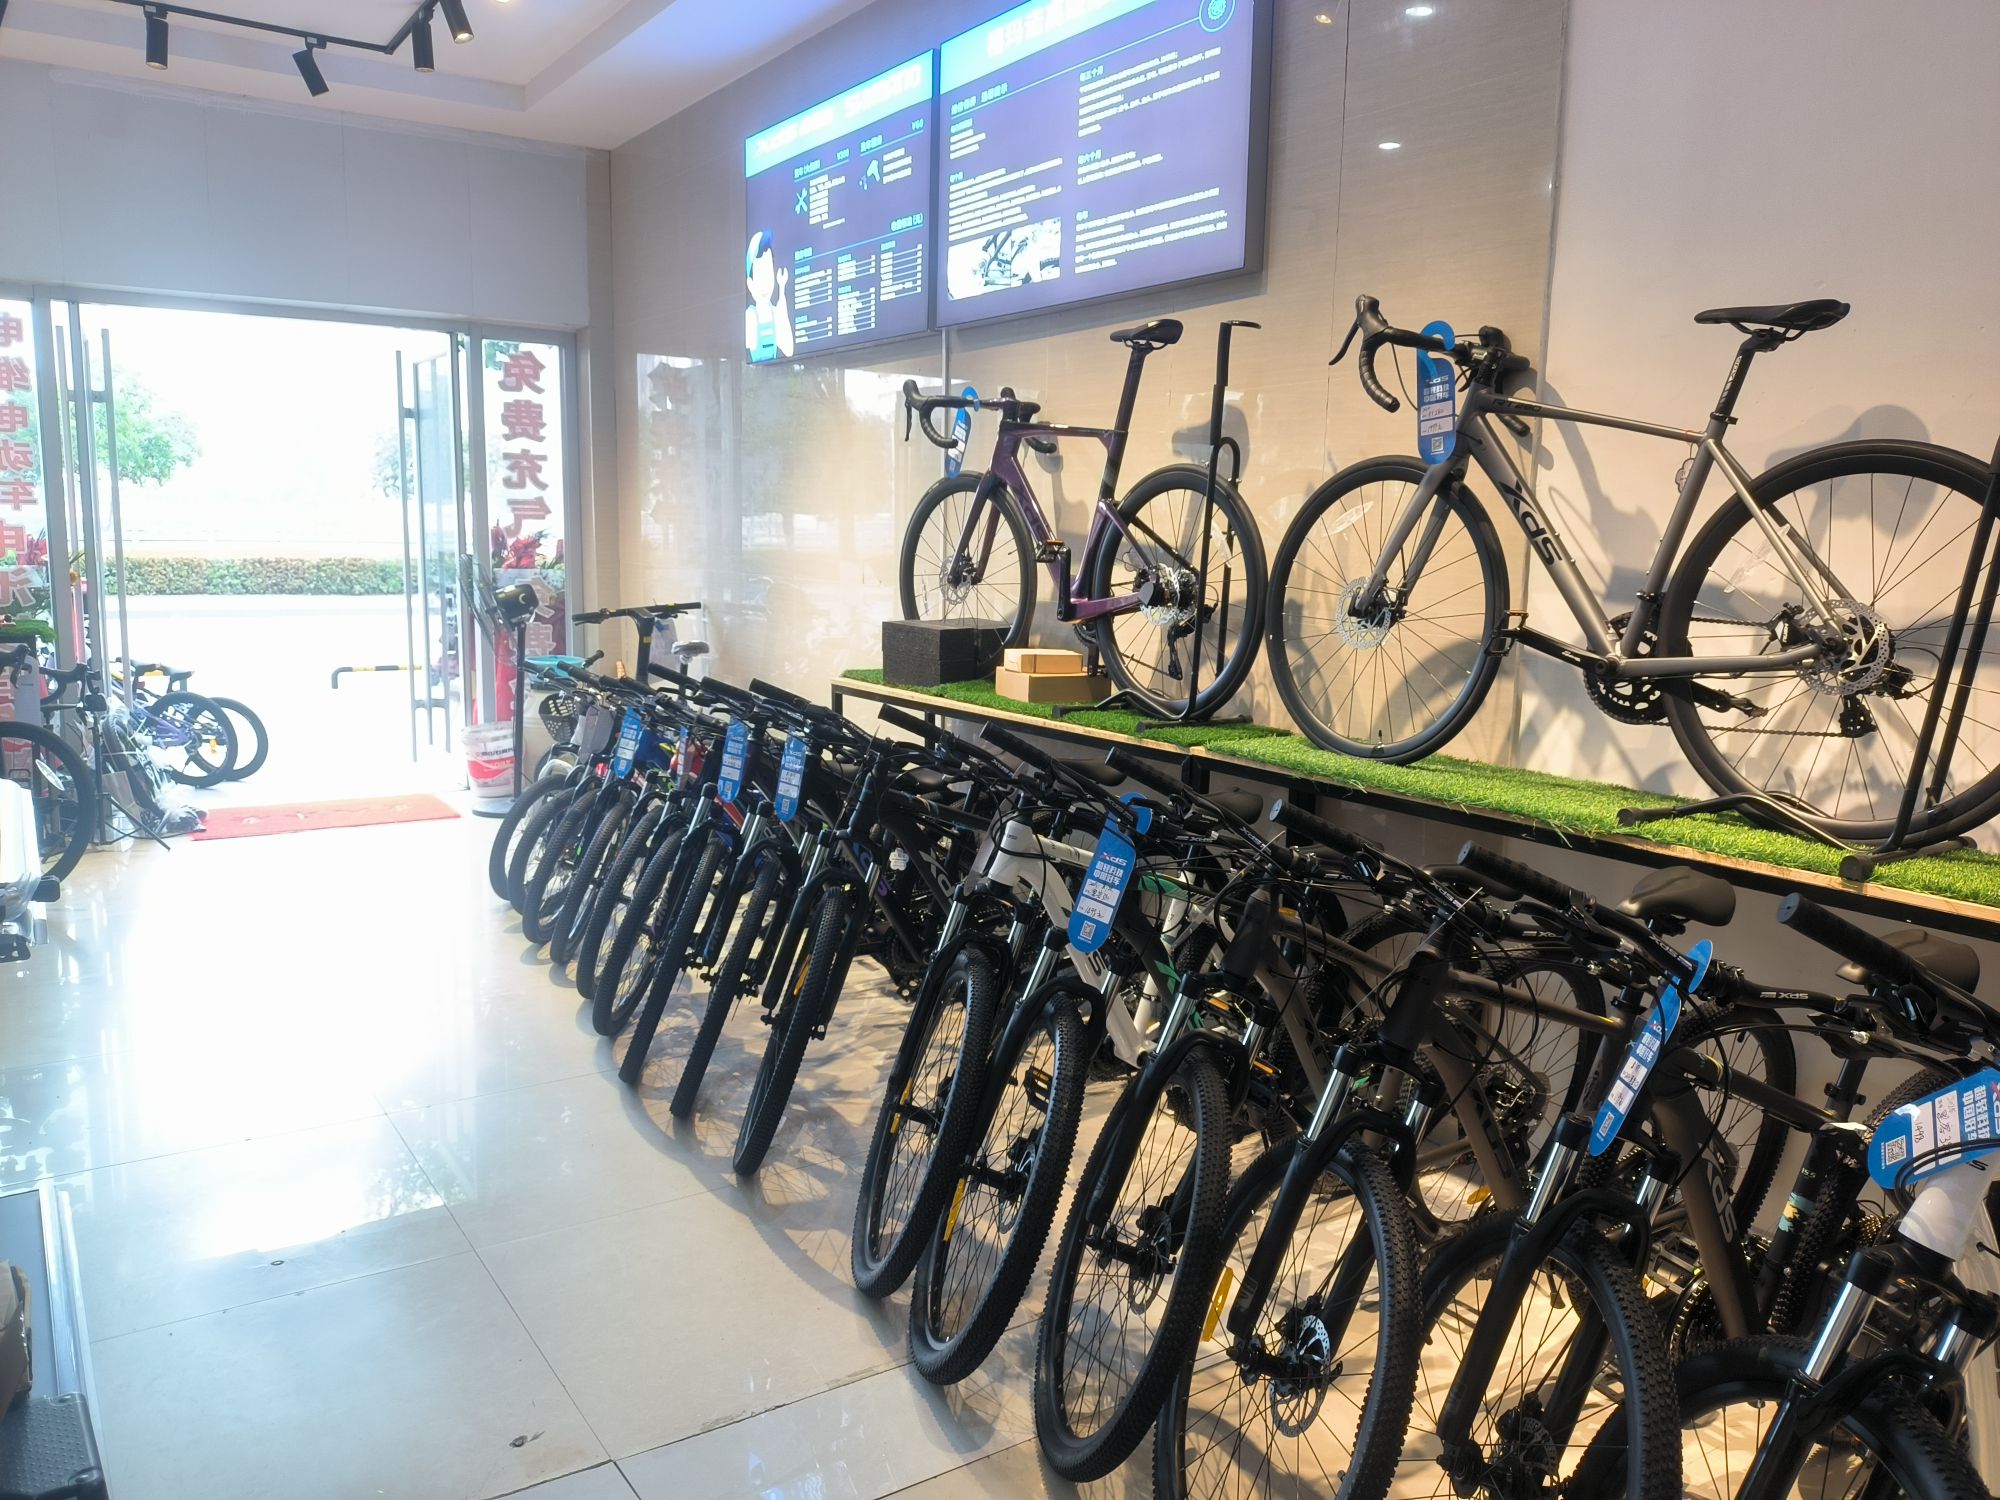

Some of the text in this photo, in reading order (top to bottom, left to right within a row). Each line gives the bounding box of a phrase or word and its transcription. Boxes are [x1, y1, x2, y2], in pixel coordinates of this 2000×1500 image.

[1499, 480, 1562, 566] Xds
[919, 847, 956, 898] Xd
[1100, 852, 1128, 867] Xds
